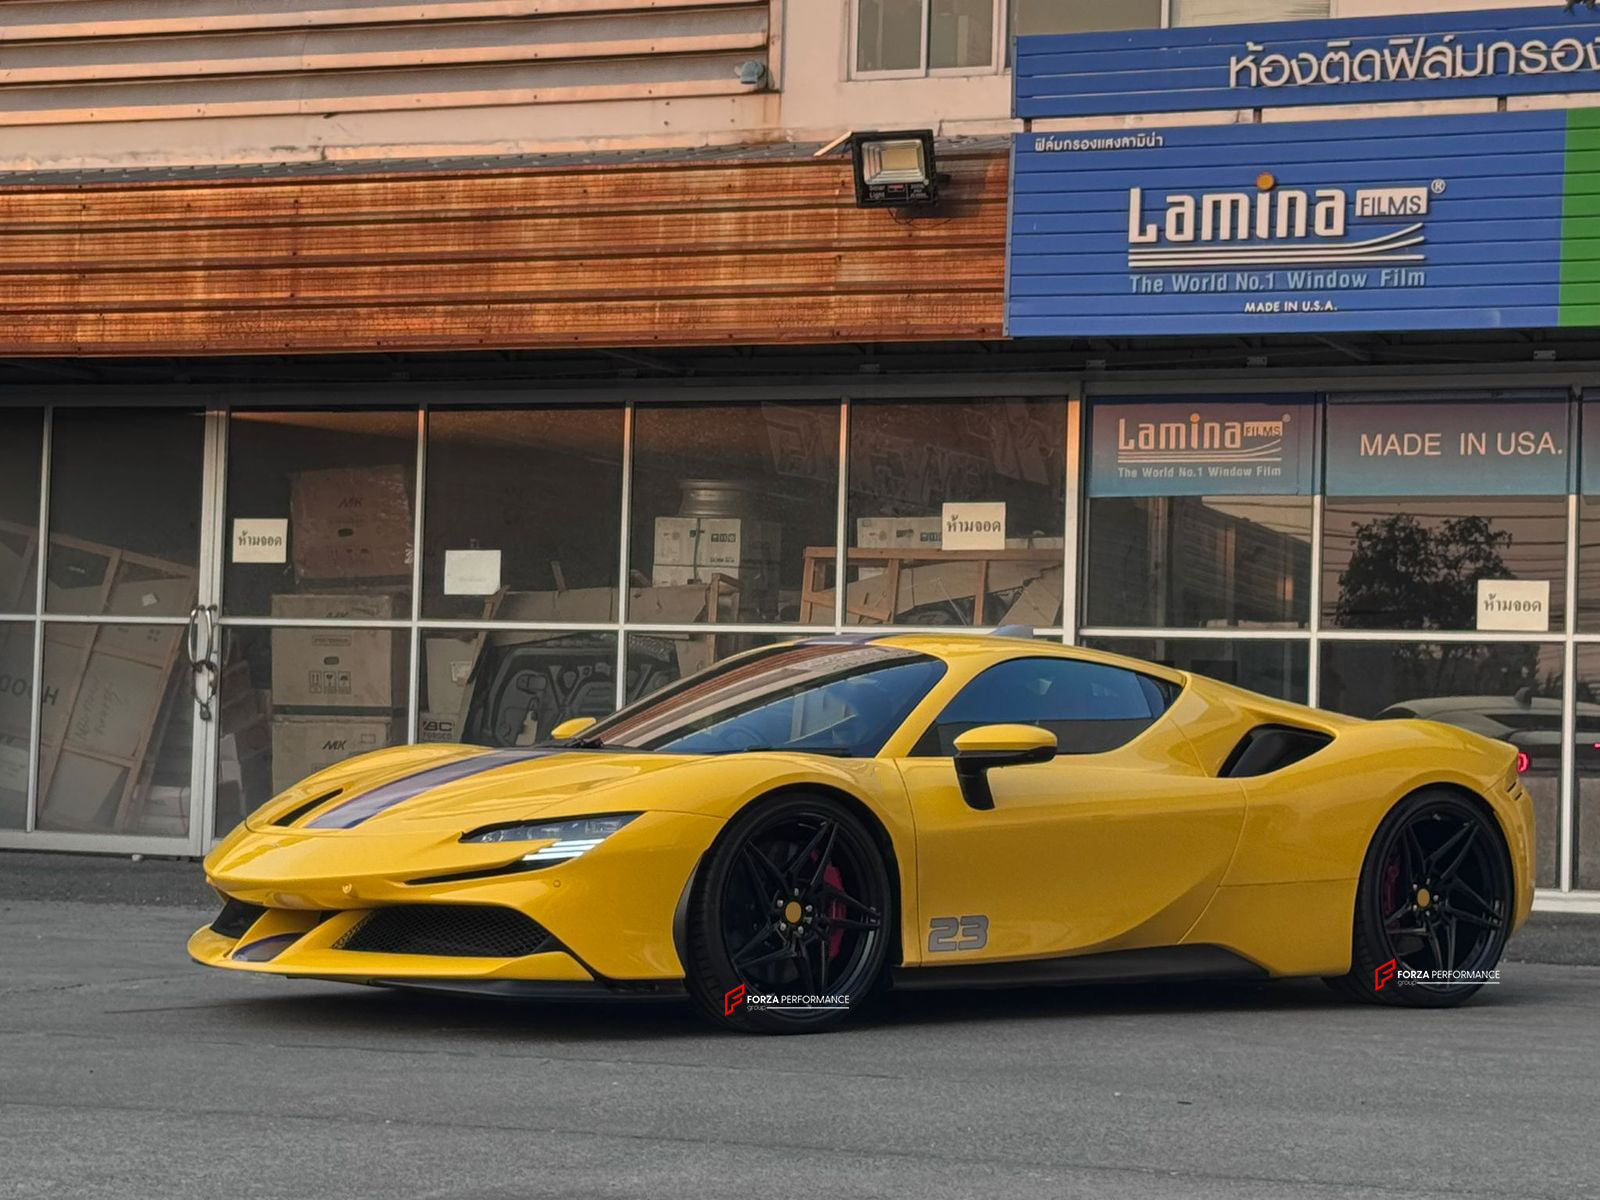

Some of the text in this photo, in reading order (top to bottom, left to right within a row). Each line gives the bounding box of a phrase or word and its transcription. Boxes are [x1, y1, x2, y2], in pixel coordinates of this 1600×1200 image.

[1127, 172, 1346, 243] Lamina
[1360, 195, 1422, 214] FILMS
[1129, 267, 1425, 293] The World No.1 Window Film
[1244, 299, 1338, 313] MADE IN U.S.A.
[1118, 413, 1241, 450] Lamina
[1360, 431, 1563, 457] MADE IN USA.
[1118, 465, 1281, 478] The World No.1 Window Film
[946, 513, 1001, 532] ห้ามจอด
[238, 529, 282, 547] ห้ามจอด
[1484, 592, 1542, 612] ห้ามจอด
[928, 914, 989, 952] 23
